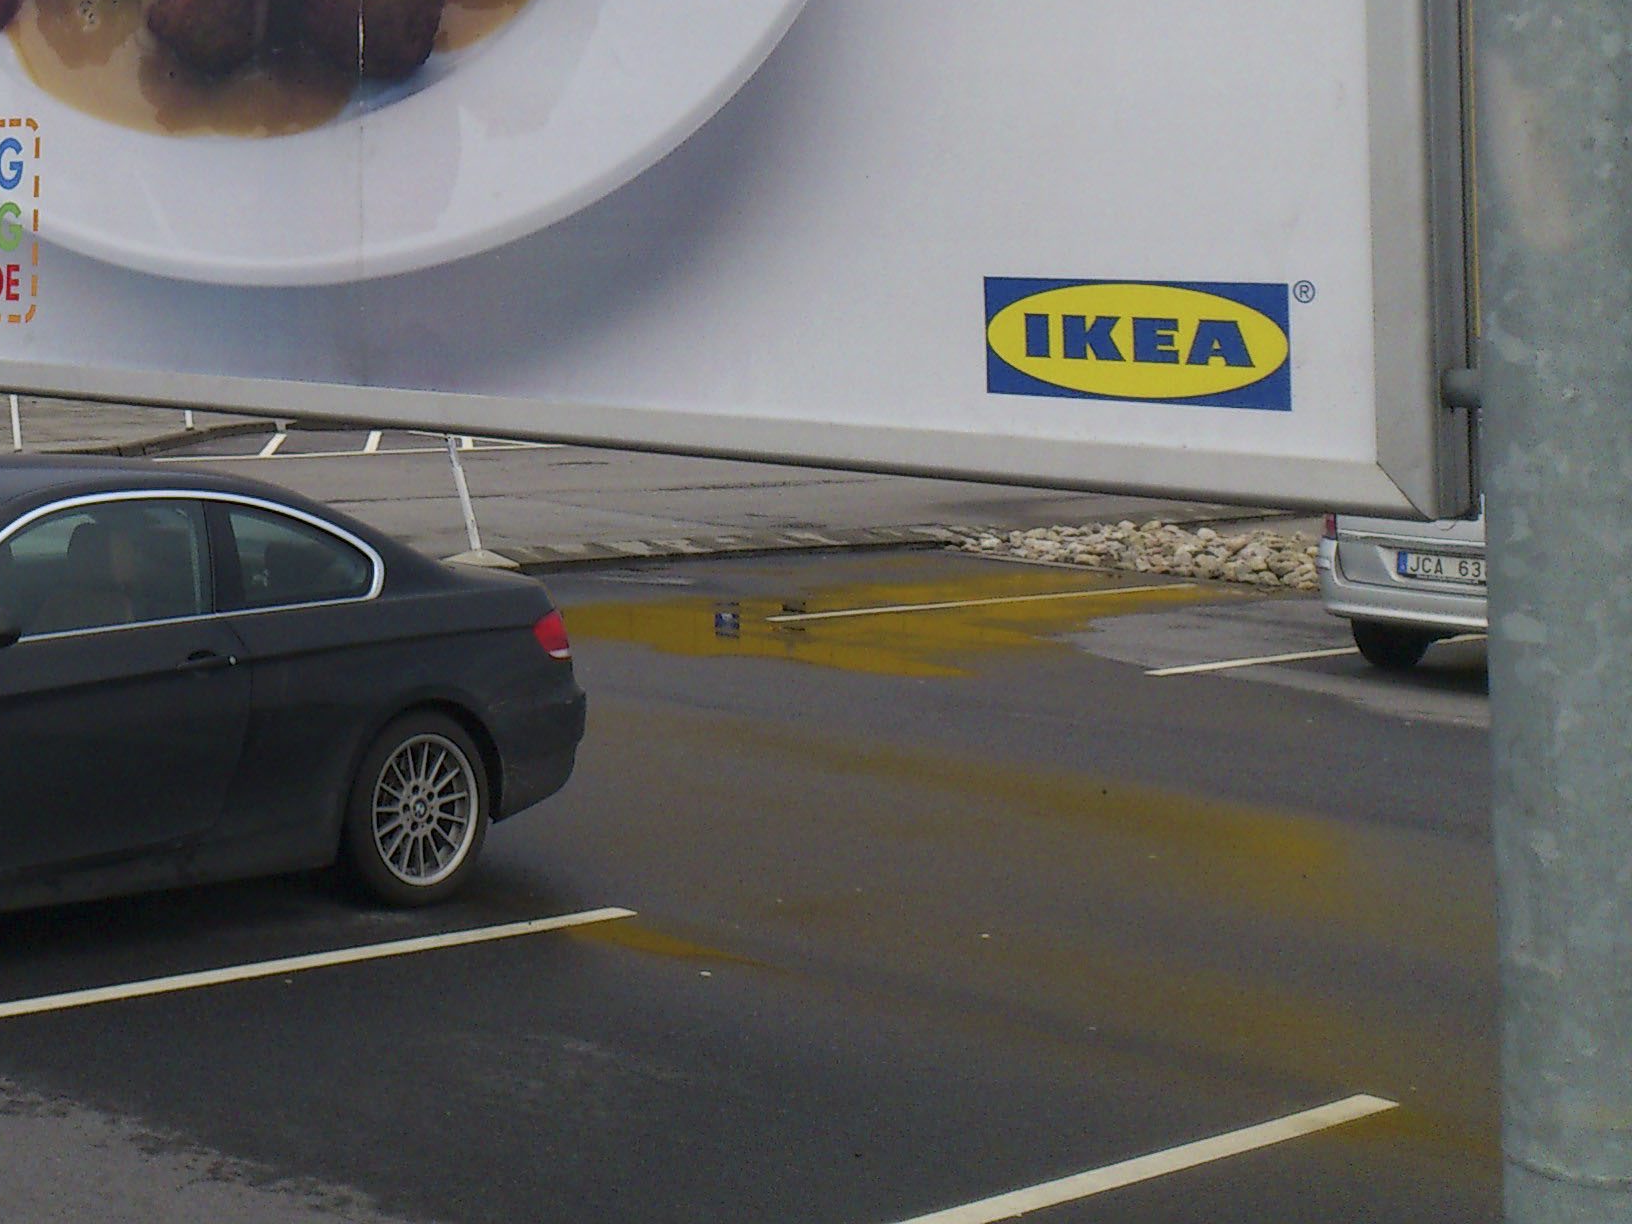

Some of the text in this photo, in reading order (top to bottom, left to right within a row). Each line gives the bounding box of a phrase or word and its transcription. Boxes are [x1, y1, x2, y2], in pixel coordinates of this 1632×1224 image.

[1024, 313, 1256, 369] IKEA
[1410, 556, 1486, 578] JCA 63
